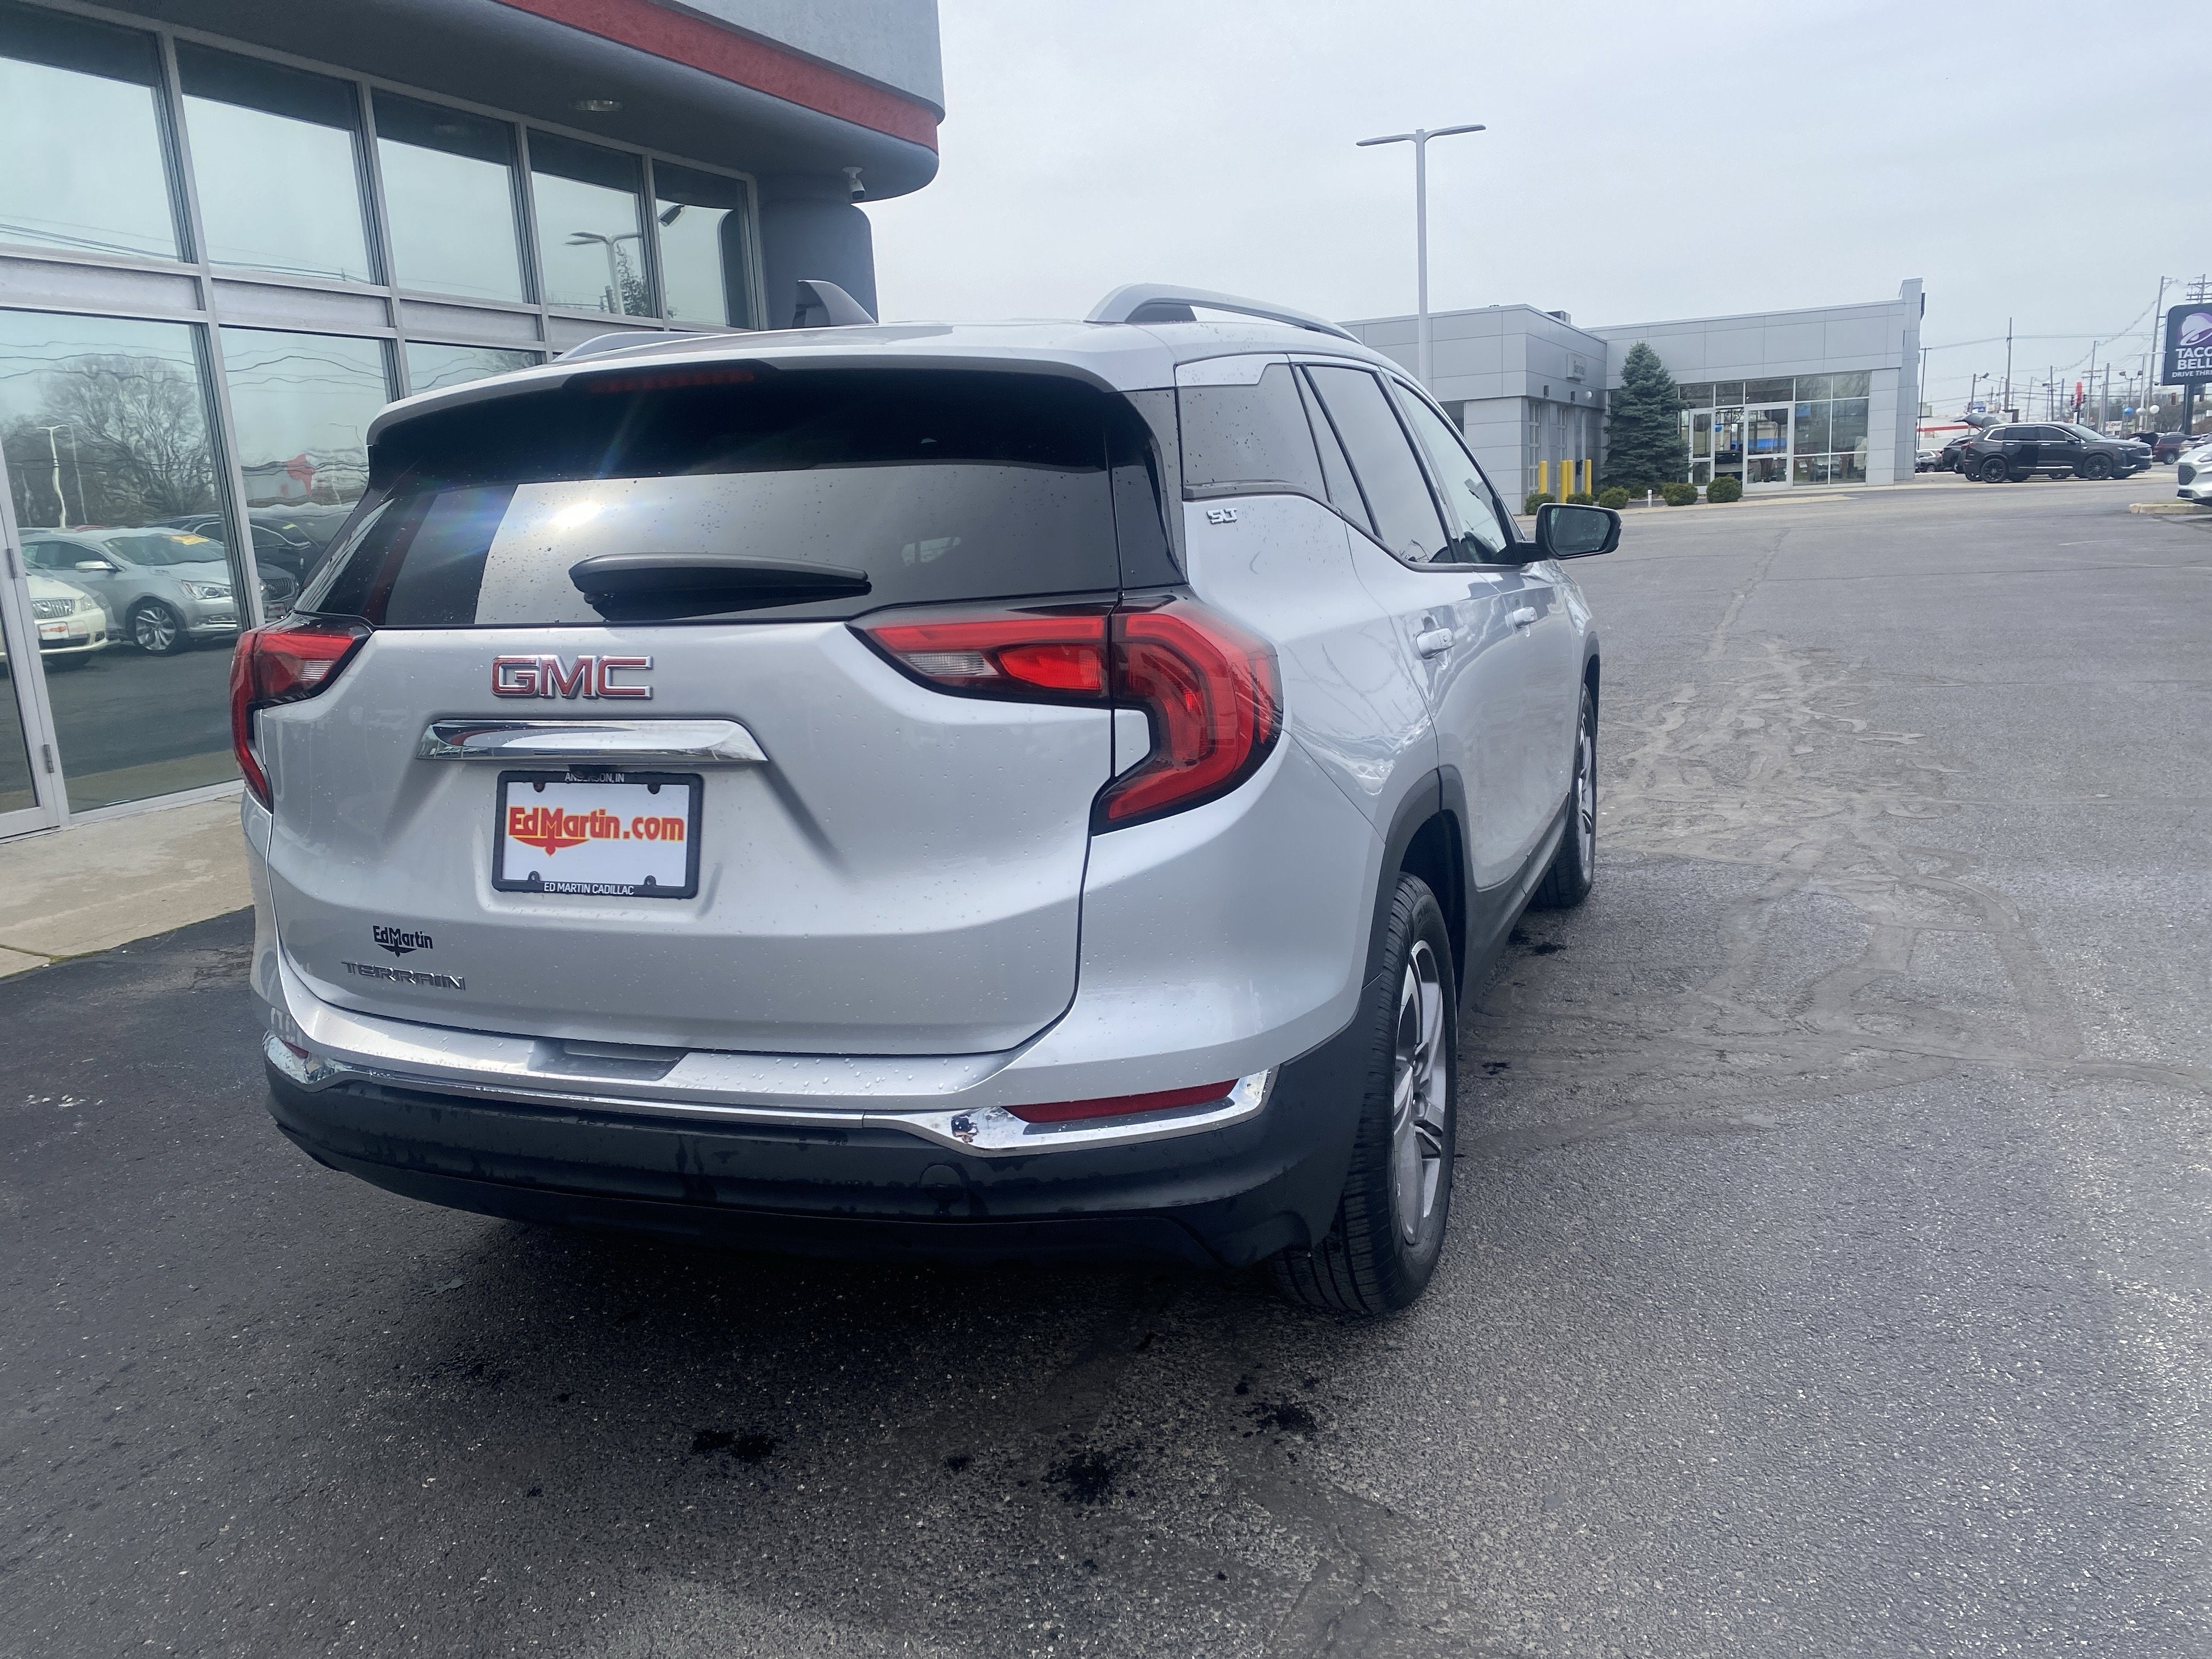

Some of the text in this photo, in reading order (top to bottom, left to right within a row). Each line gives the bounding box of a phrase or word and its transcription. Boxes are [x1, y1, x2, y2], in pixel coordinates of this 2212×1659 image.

[2175, 347, 2212, 358] TACO
[2177, 358, 2212, 370] BELL
[1207, 508, 1237, 524] SLT
[491, 655, 653, 699] GMC
[615, 773, 624, 782] IN
[508, 806, 685, 842] EdMartin.com
[544, 882, 634, 895] ED MARTIN CADILLAC
[373, 925, 433, 949] EdMartin
[341, 961, 466, 990] TERRAIN
